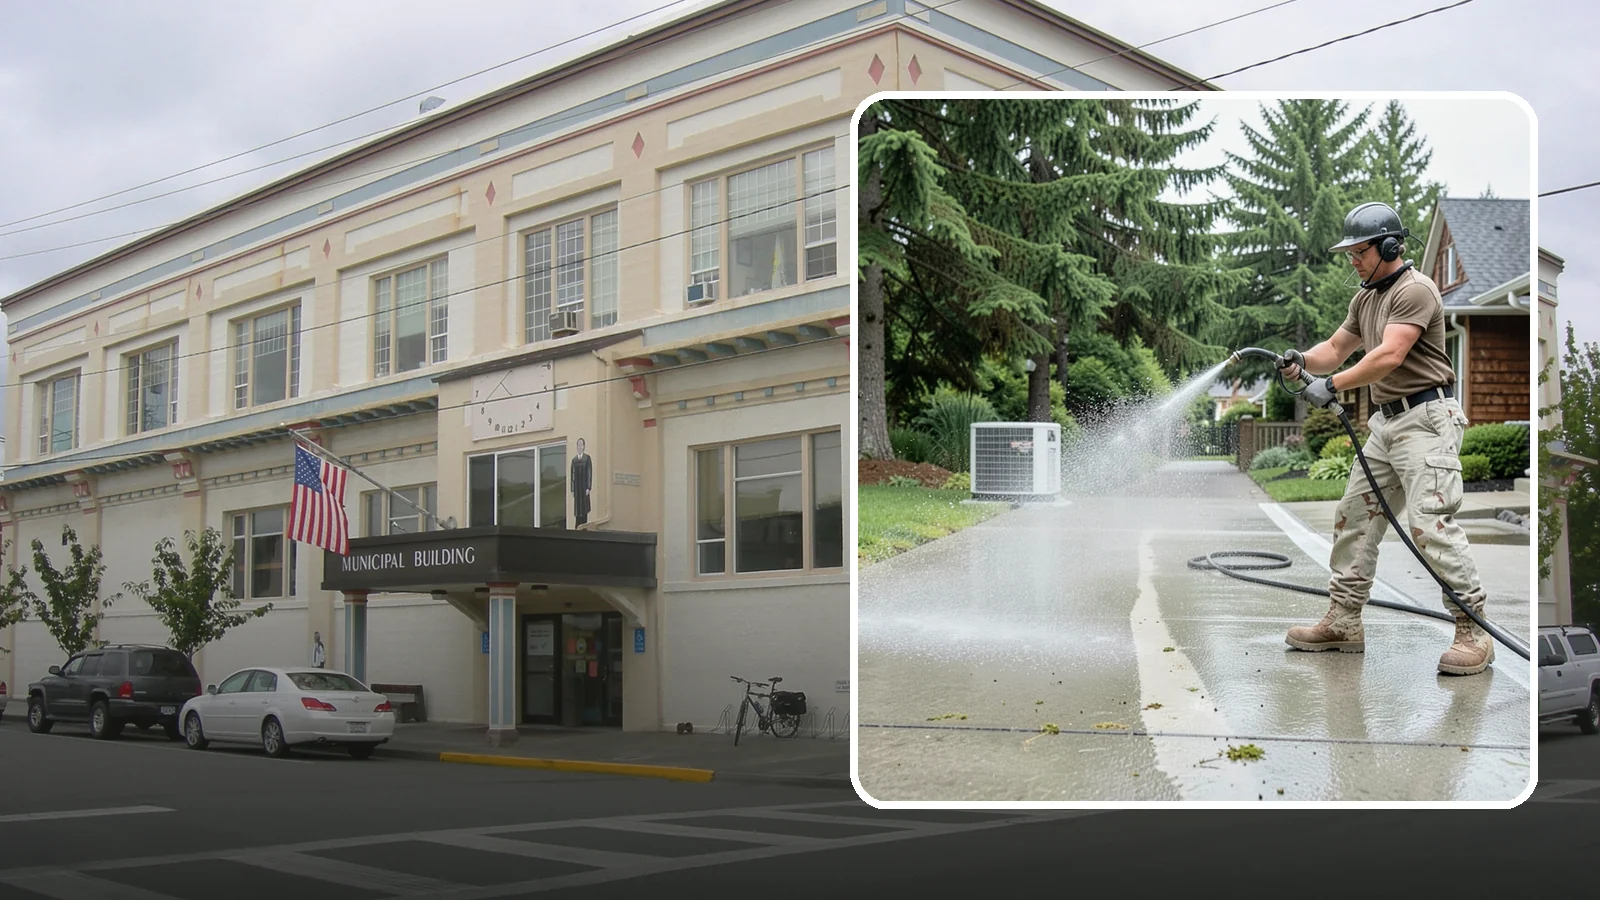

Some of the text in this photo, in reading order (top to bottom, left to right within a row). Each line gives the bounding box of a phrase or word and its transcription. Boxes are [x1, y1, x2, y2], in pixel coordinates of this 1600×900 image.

[480, 407, 485, 415] 8
[507, 425, 513, 433] 12
[521, 420, 525, 428] 2
[536, 402, 540, 410] 4
[342, 546, 475, 572] MUNICIPAL BUILDING
